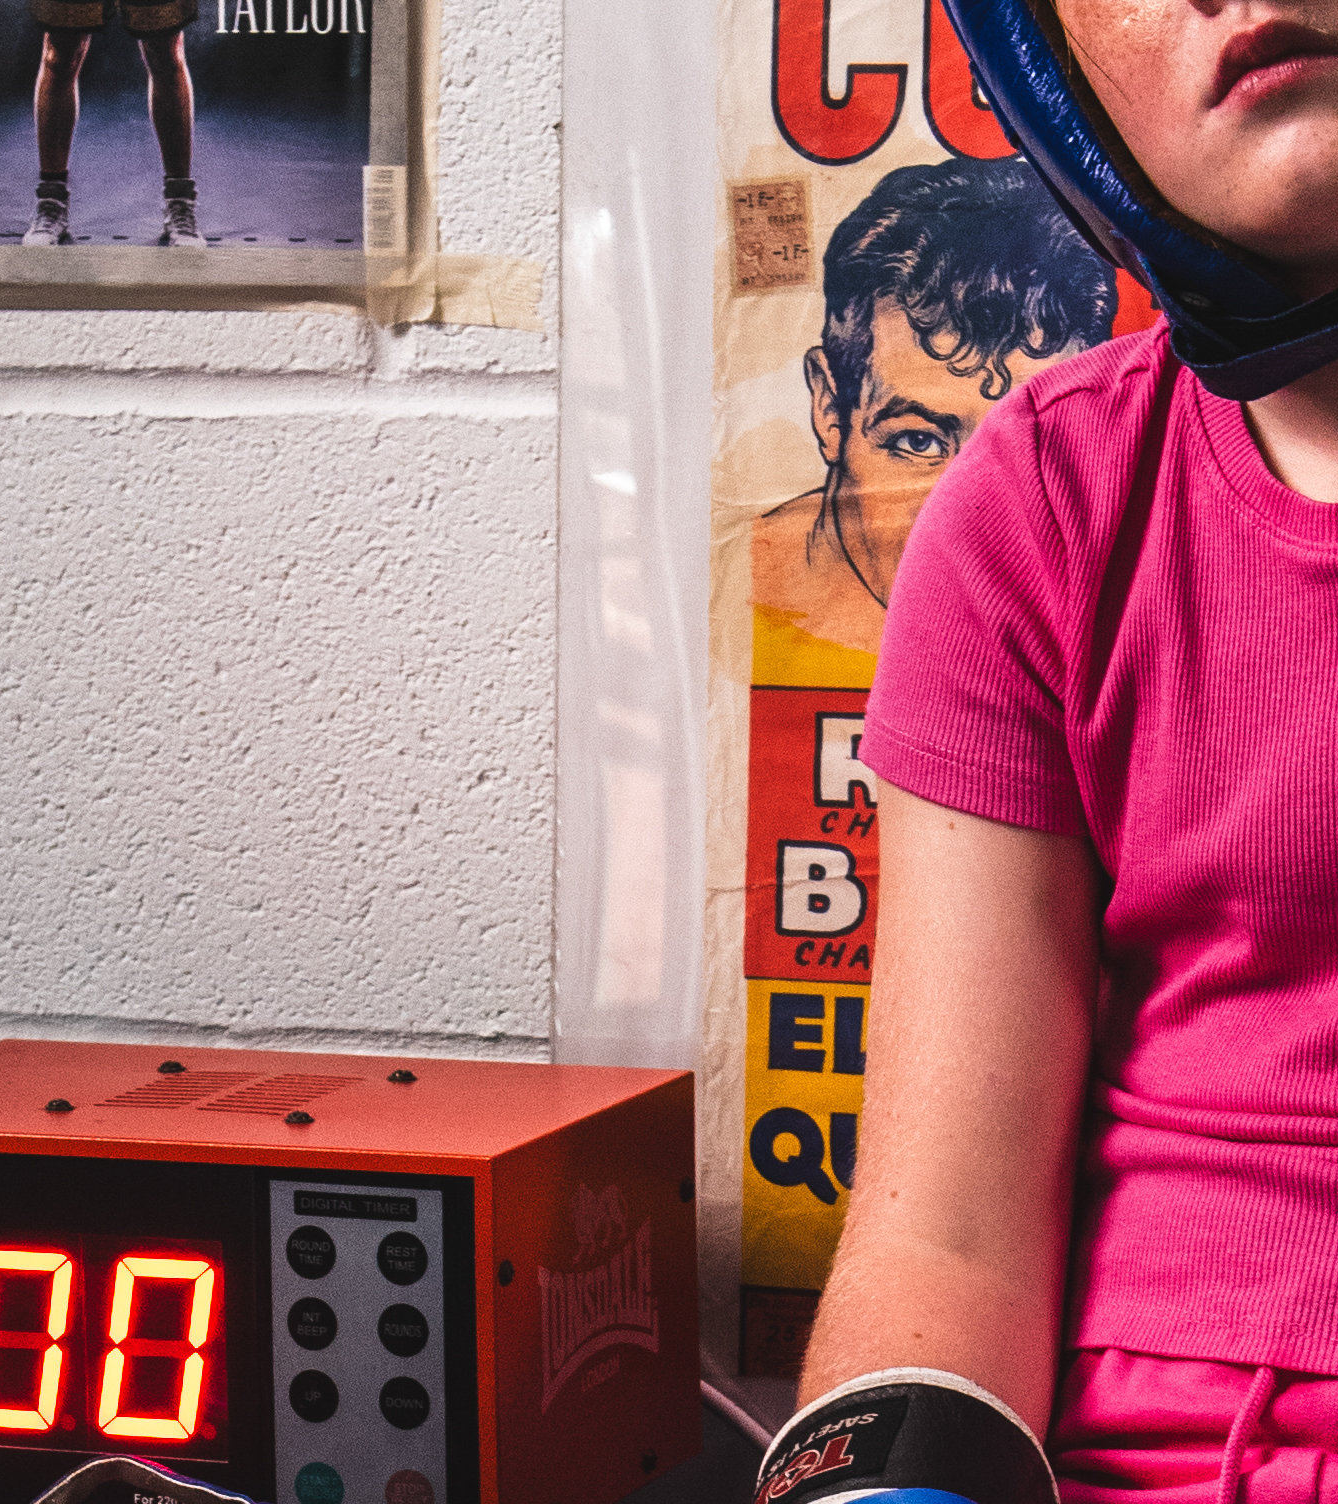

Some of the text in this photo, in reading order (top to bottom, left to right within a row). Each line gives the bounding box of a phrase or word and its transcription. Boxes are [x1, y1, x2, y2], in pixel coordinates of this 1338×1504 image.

[300, 1197, 411, 1216] DIGITAL TIMER
[291, 1239, 331, 1252] ROUND
[385, 1246, 418, 1258] REST
[298, 1254, 323, 1266] TIME
[387, 1259, 417, 1272] TIME
[302, 1311, 321, 1324] INT
[297, 1324, 328, 1337] BEEP
[384, 1323, 423, 1339] ROUNDS
[305, 1390, 323, 1402] UP
[385, 1397, 424, 1410] DOWN
[134, 1494, 154, 1504] For
